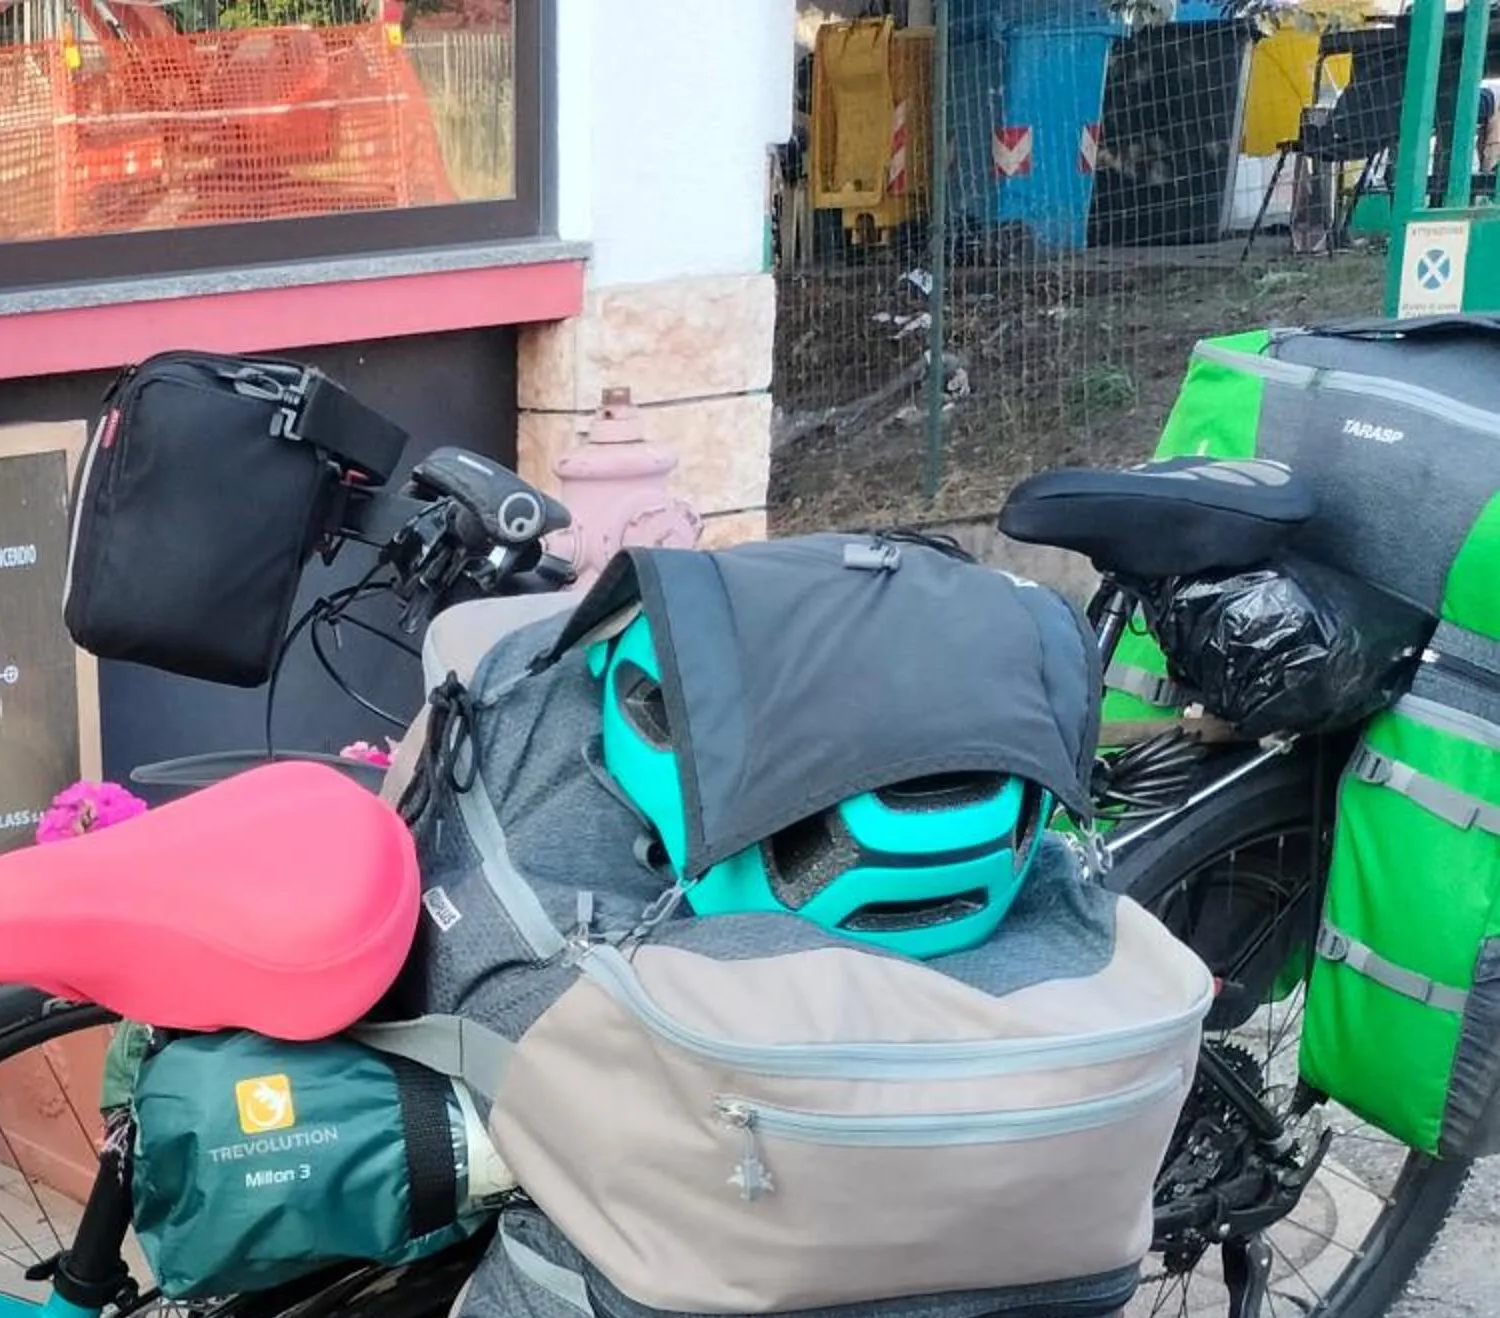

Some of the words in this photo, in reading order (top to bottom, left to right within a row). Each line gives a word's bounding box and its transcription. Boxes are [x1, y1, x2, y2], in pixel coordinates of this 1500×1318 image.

[1342, 419, 1404, 444] TARASP
[208, 1126, 338, 1162] TREVOLUTION
[299, 1163, 312, 1180] 3
